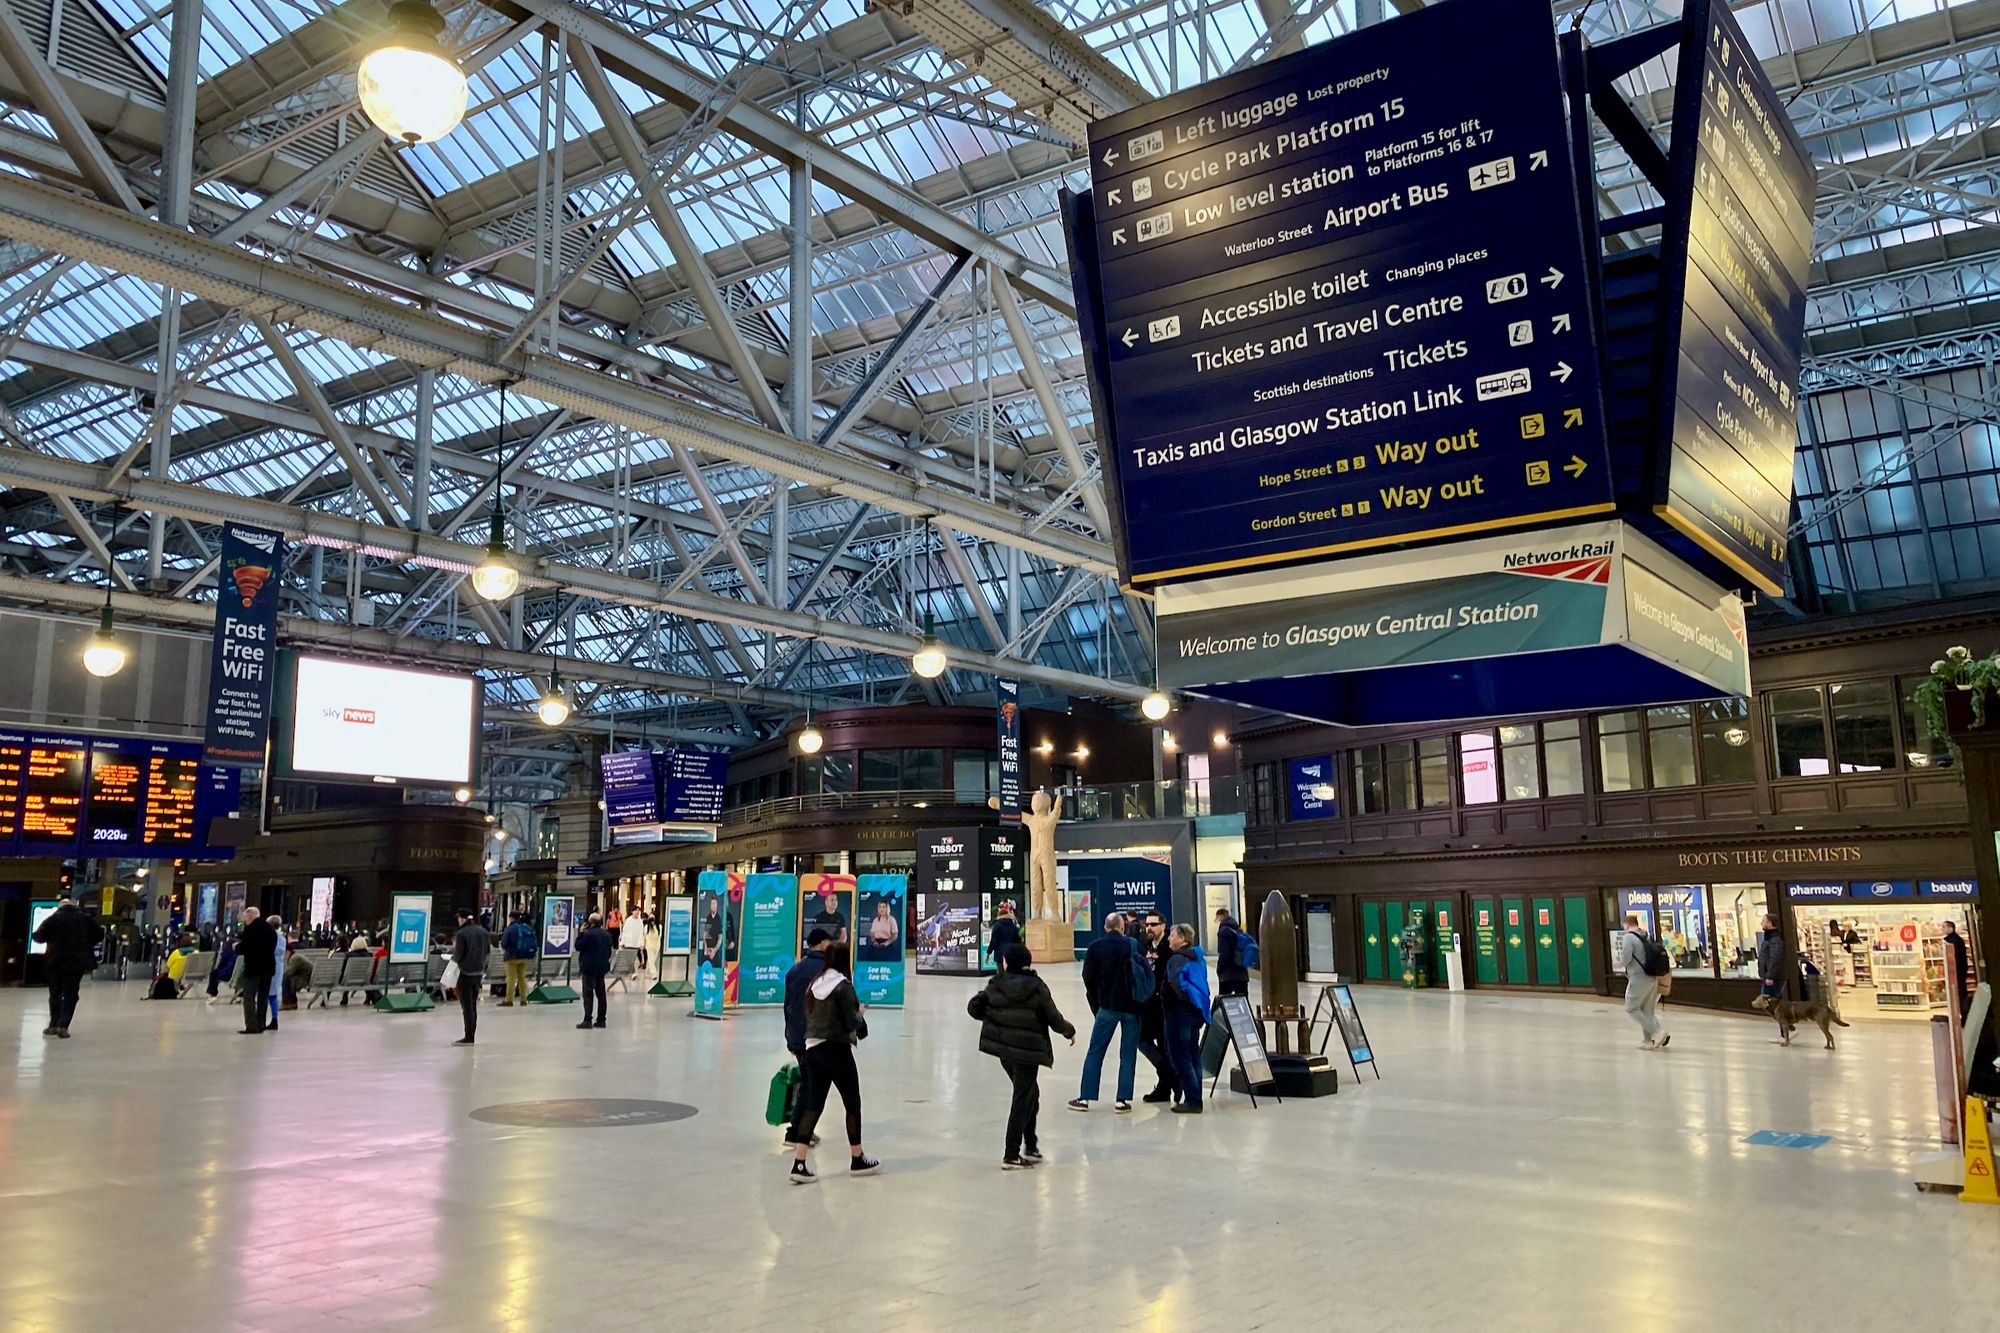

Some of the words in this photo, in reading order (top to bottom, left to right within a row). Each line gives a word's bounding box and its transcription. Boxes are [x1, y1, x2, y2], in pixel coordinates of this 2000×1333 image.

[1175, 117, 1216, 144] Left
[1221, 92, 1298, 128] luggage
[1308, 84, 1334, 101] Lost
[1336, 66, 1390, 92] property
[1736, 66, 1764, 125] Customer
[1163, 160, 1220, 190] Cycle
[1225, 141, 1271, 171] Park
[1276, 110, 1374, 155] Platform
[1380, 97, 1405, 122] 15
[1365, 138, 1418, 162] Platform
[1421, 131, 1435, 146] 15
[1438, 127, 1457, 141] for
[1461, 118, 1481, 135] lift
[1367, 164, 1380, 177] to
[1383, 147, 1444, 172] Platforms
[1448, 140, 1462, 154] 16
[1466, 135, 1477, 149] &
[1479, 129, 1494, 144] 17
[1184, 202, 1224, 228] Low
[1229, 183, 1274, 214] level
[1281, 163, 1354, 199] station
[1224, 233, 1275, 258] Waterloo
[1278, 224, 1313, 243] Street
[1323, 191, 1402, 230] Airport
[1407, 182, 1449, 207] Bus
[1200, 286, 1306, 330] Accessible
[1311, 268, 1369, 301] toilet
[1386, 261, 1444, 282] Changing
[1447, 249, 1488, 269] places
[1192, 340, 1264, 373] Tickets
[1270, 327, 1308, 355] and
[1313, 309, 1378, 344] Travel
[1384, 294, 1463, 327] Centre
[1253, 382, 1300, 402] Scottish
[1302, 367, 1375, 391] destinations
[1383, 339, 1468, 372] Tickets
[1750, 348, 1769, 384] Airport
[1133, 443, 1184, 469] Taxis
[1189, 432, 1225, 458] and
[1230, 417, 1319, 449] Glasgow
[1325, 399, 1407, 430] Station
[1413, 384, 1463, 413] Link
[1259, 472, 1291, 488] Hope
[1294, 463, 1333, 481] Street
[1375, 441, 1427, 465] Way
[1435, 428, 1480, 454] out
[1251, 514, 1296, 531] Gordon
[1299, 507, 1337, 524] Street
[1380, 485, 1432, 509] Way
[1440, 474, 1484, 500] out
[1503, 540, 1615, 568] NetworkRail
[224, 616, 266, 641] Fast
[1179, 635, 1257, 658] Welcome
[1262, 631, 1280, 649] to
[1285, 621, 1371, 646] Glasgow
[1375, 607, 1453, 636] Central
[1457, 602, 1539, 627] Station
[1633, 591, 1663, 625] Welcome
[1663, 609, 1670, 629] to
[1670, 612, 1696, 643] Glasgow
[1695, 626, 1715, 653] Central
[1714, 637, 1734, 663] Station
[222, 638, 265, 662] Free
[222, 659, 263, 682] WiFi
[218, 698, 230, 706] our
[247, 700, 261, 709] free
[221, 688, 250, 699] Connect
[251, 691, 259, 700] to
[215, 707, 229, 715] and
[229, 708, 262, 719] unlimited
[225, 718, 250, 727] station
[322, 708, 340, 720] sky
[344, 709, 374, 723] news
[234, 729, 256, 739] today.
[1001, 735, 1018, 748] Fast
[1001, 748, 1018, 760] Free
[1002, 760, 1018, 773] WiFi
[1303, 800, 1323, 809] Central
[931, 844, 964, 854] TISSOT
[990, 843, 1014, 853] TISSOT
[1678, 852, 1729, 867] BOOTS
[1732, 850, 1769, 864] THE
[1772, 846, 1862, 863] CHEMISTS
[1113, 881, 1126, 889] Fast
[1126, 881, 1156, 895] WiFi
[1789, 885, 1844, 897] pharmacy
[1931, 882, 1973, 894] beauty
[1628, 890, 1653, 906] pleas
[1657, 893, 1673, 906] pay
